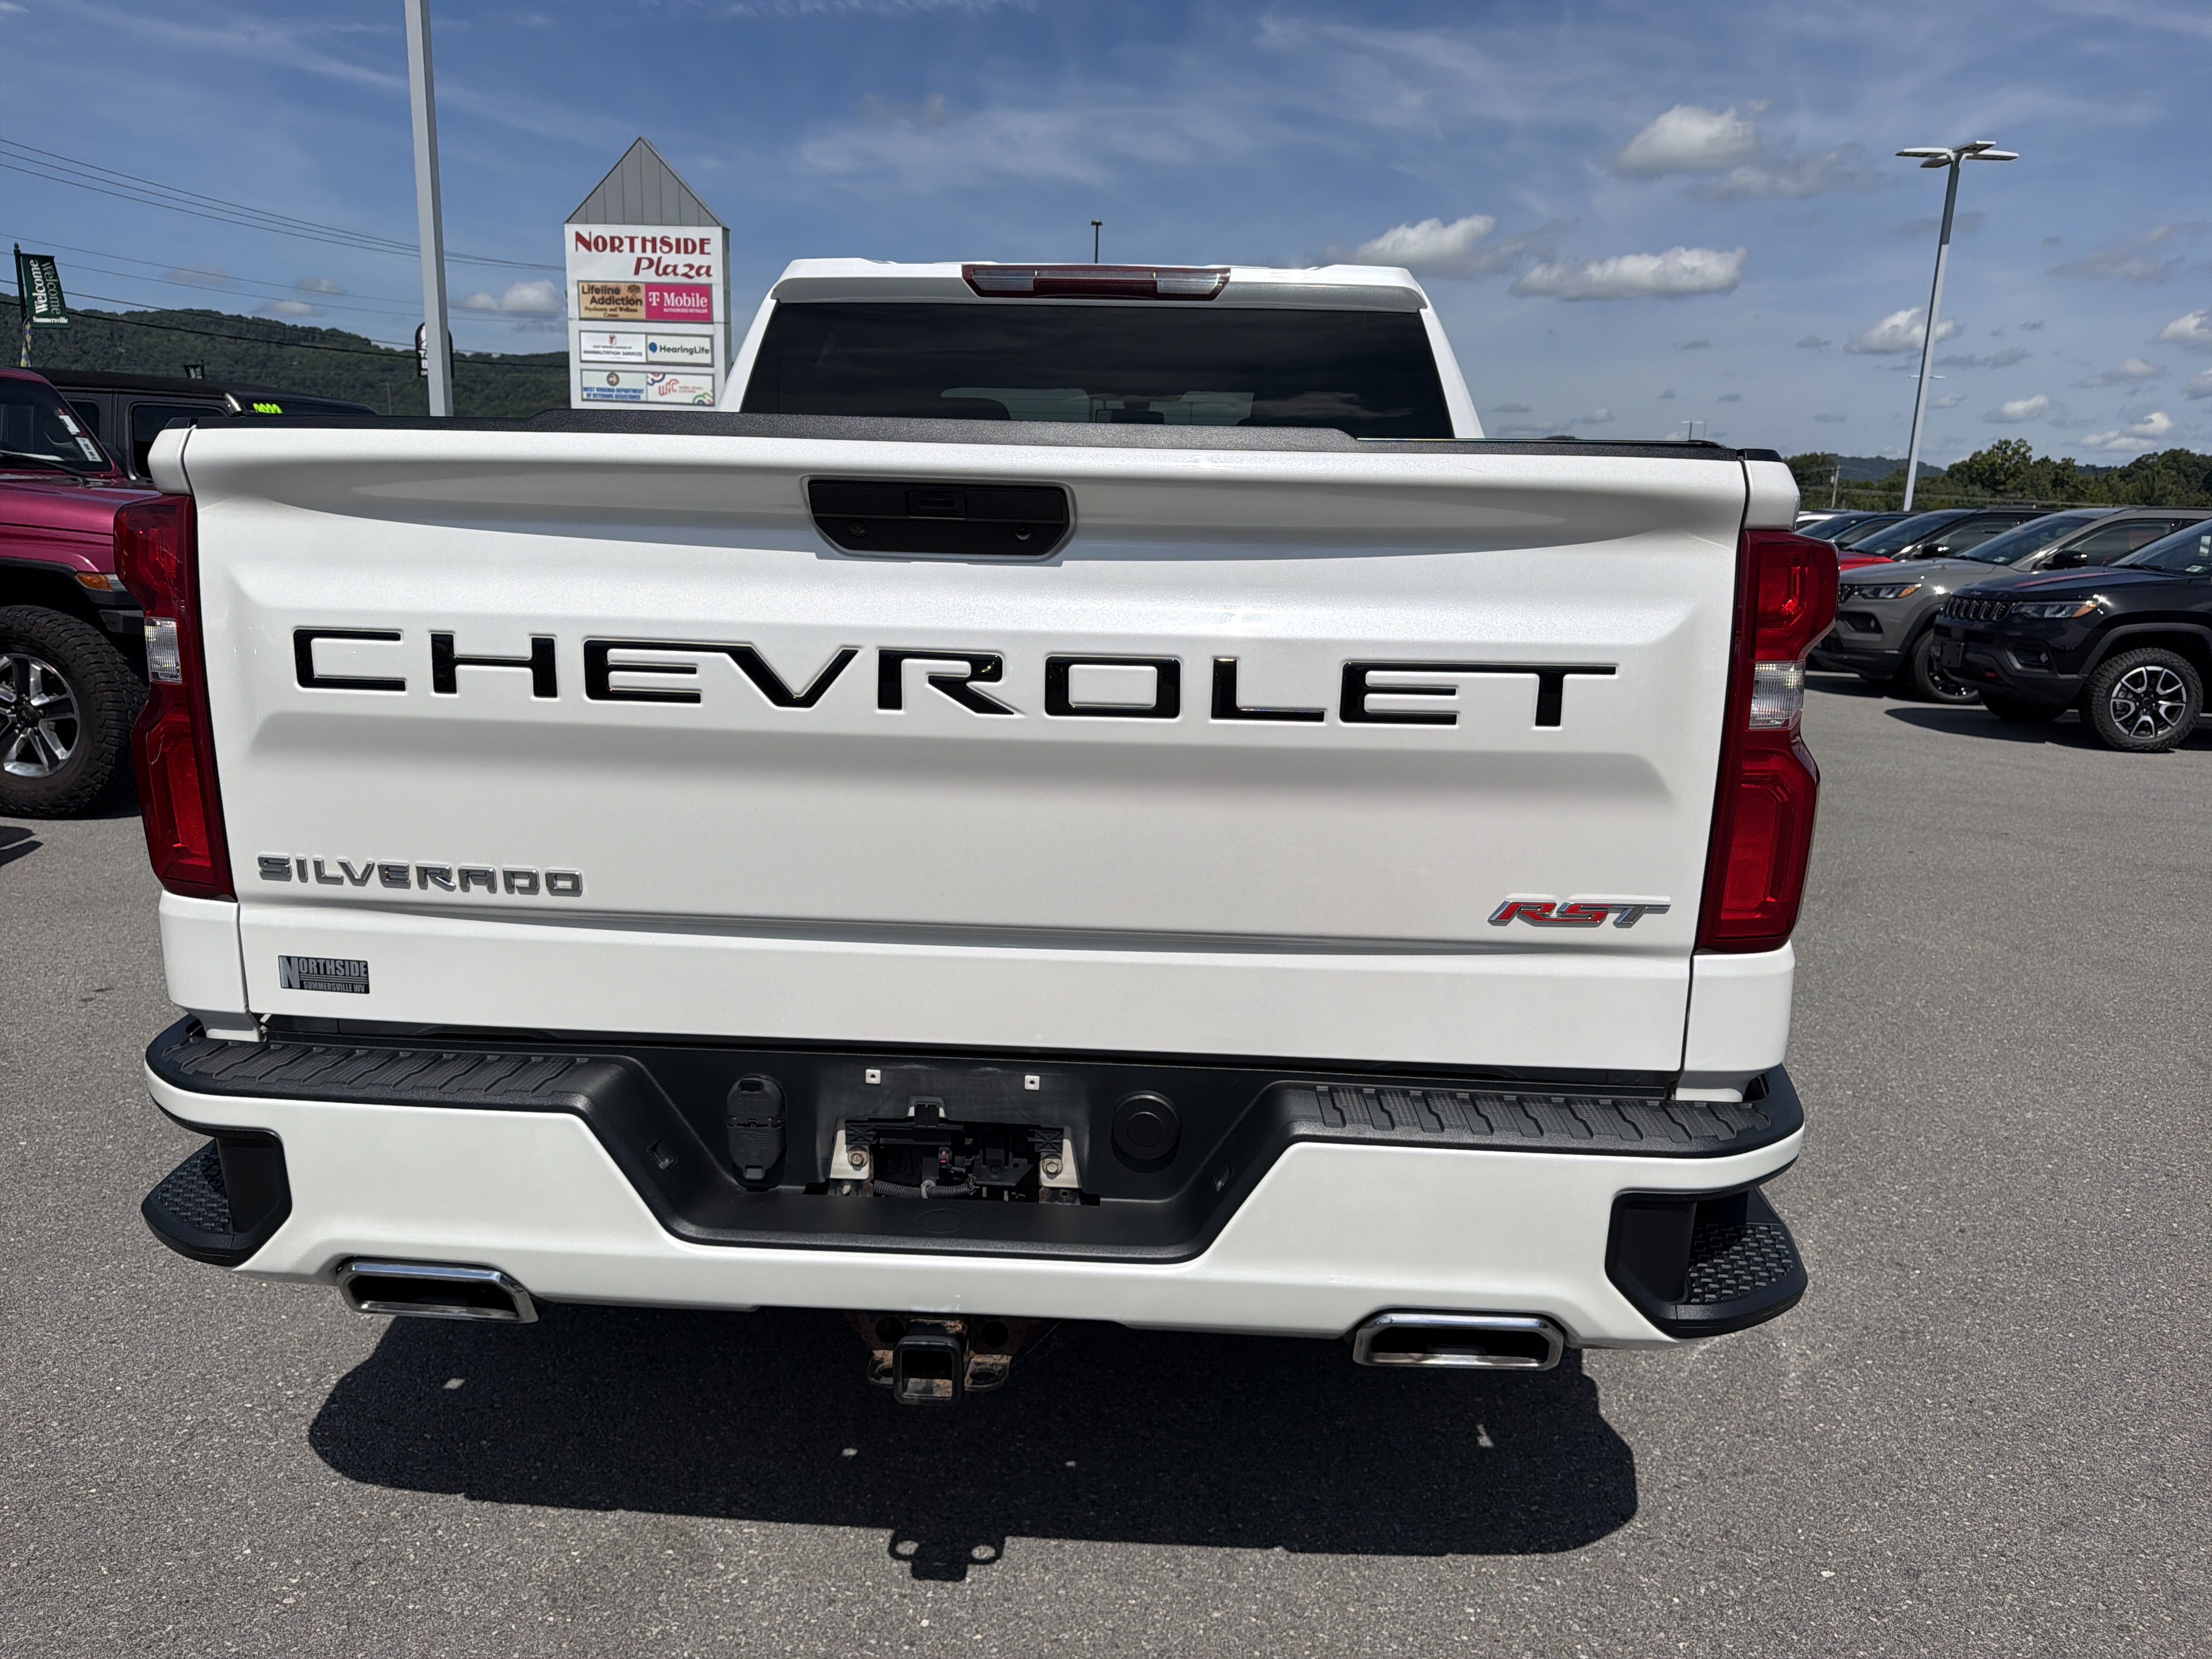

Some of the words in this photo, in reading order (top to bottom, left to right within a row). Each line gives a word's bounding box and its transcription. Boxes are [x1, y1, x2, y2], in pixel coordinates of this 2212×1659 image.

[575, 231, 712, 255] NORTHSIDE
[633, 256, 713, 279] Plaza
[29, 259, 48, 314] Welcome
[41, 261, 61, 315] Welcome
[582, 285, 620, 295] Lifeline
[590, 296, 642, 306] Addiction
[663, 292, 708, 307] Mobile
[659, 345, 709, 356] HearingLife
[294, 628, 1616, 727] CHEVROLET
[257, 855, 583, 895] SILVERADO
[1487, 900, 1671, 928] RST
[279, 956, 368, 988] NORTHSIDE
[303, 981, 353, 992] SUMMERSVILLE
